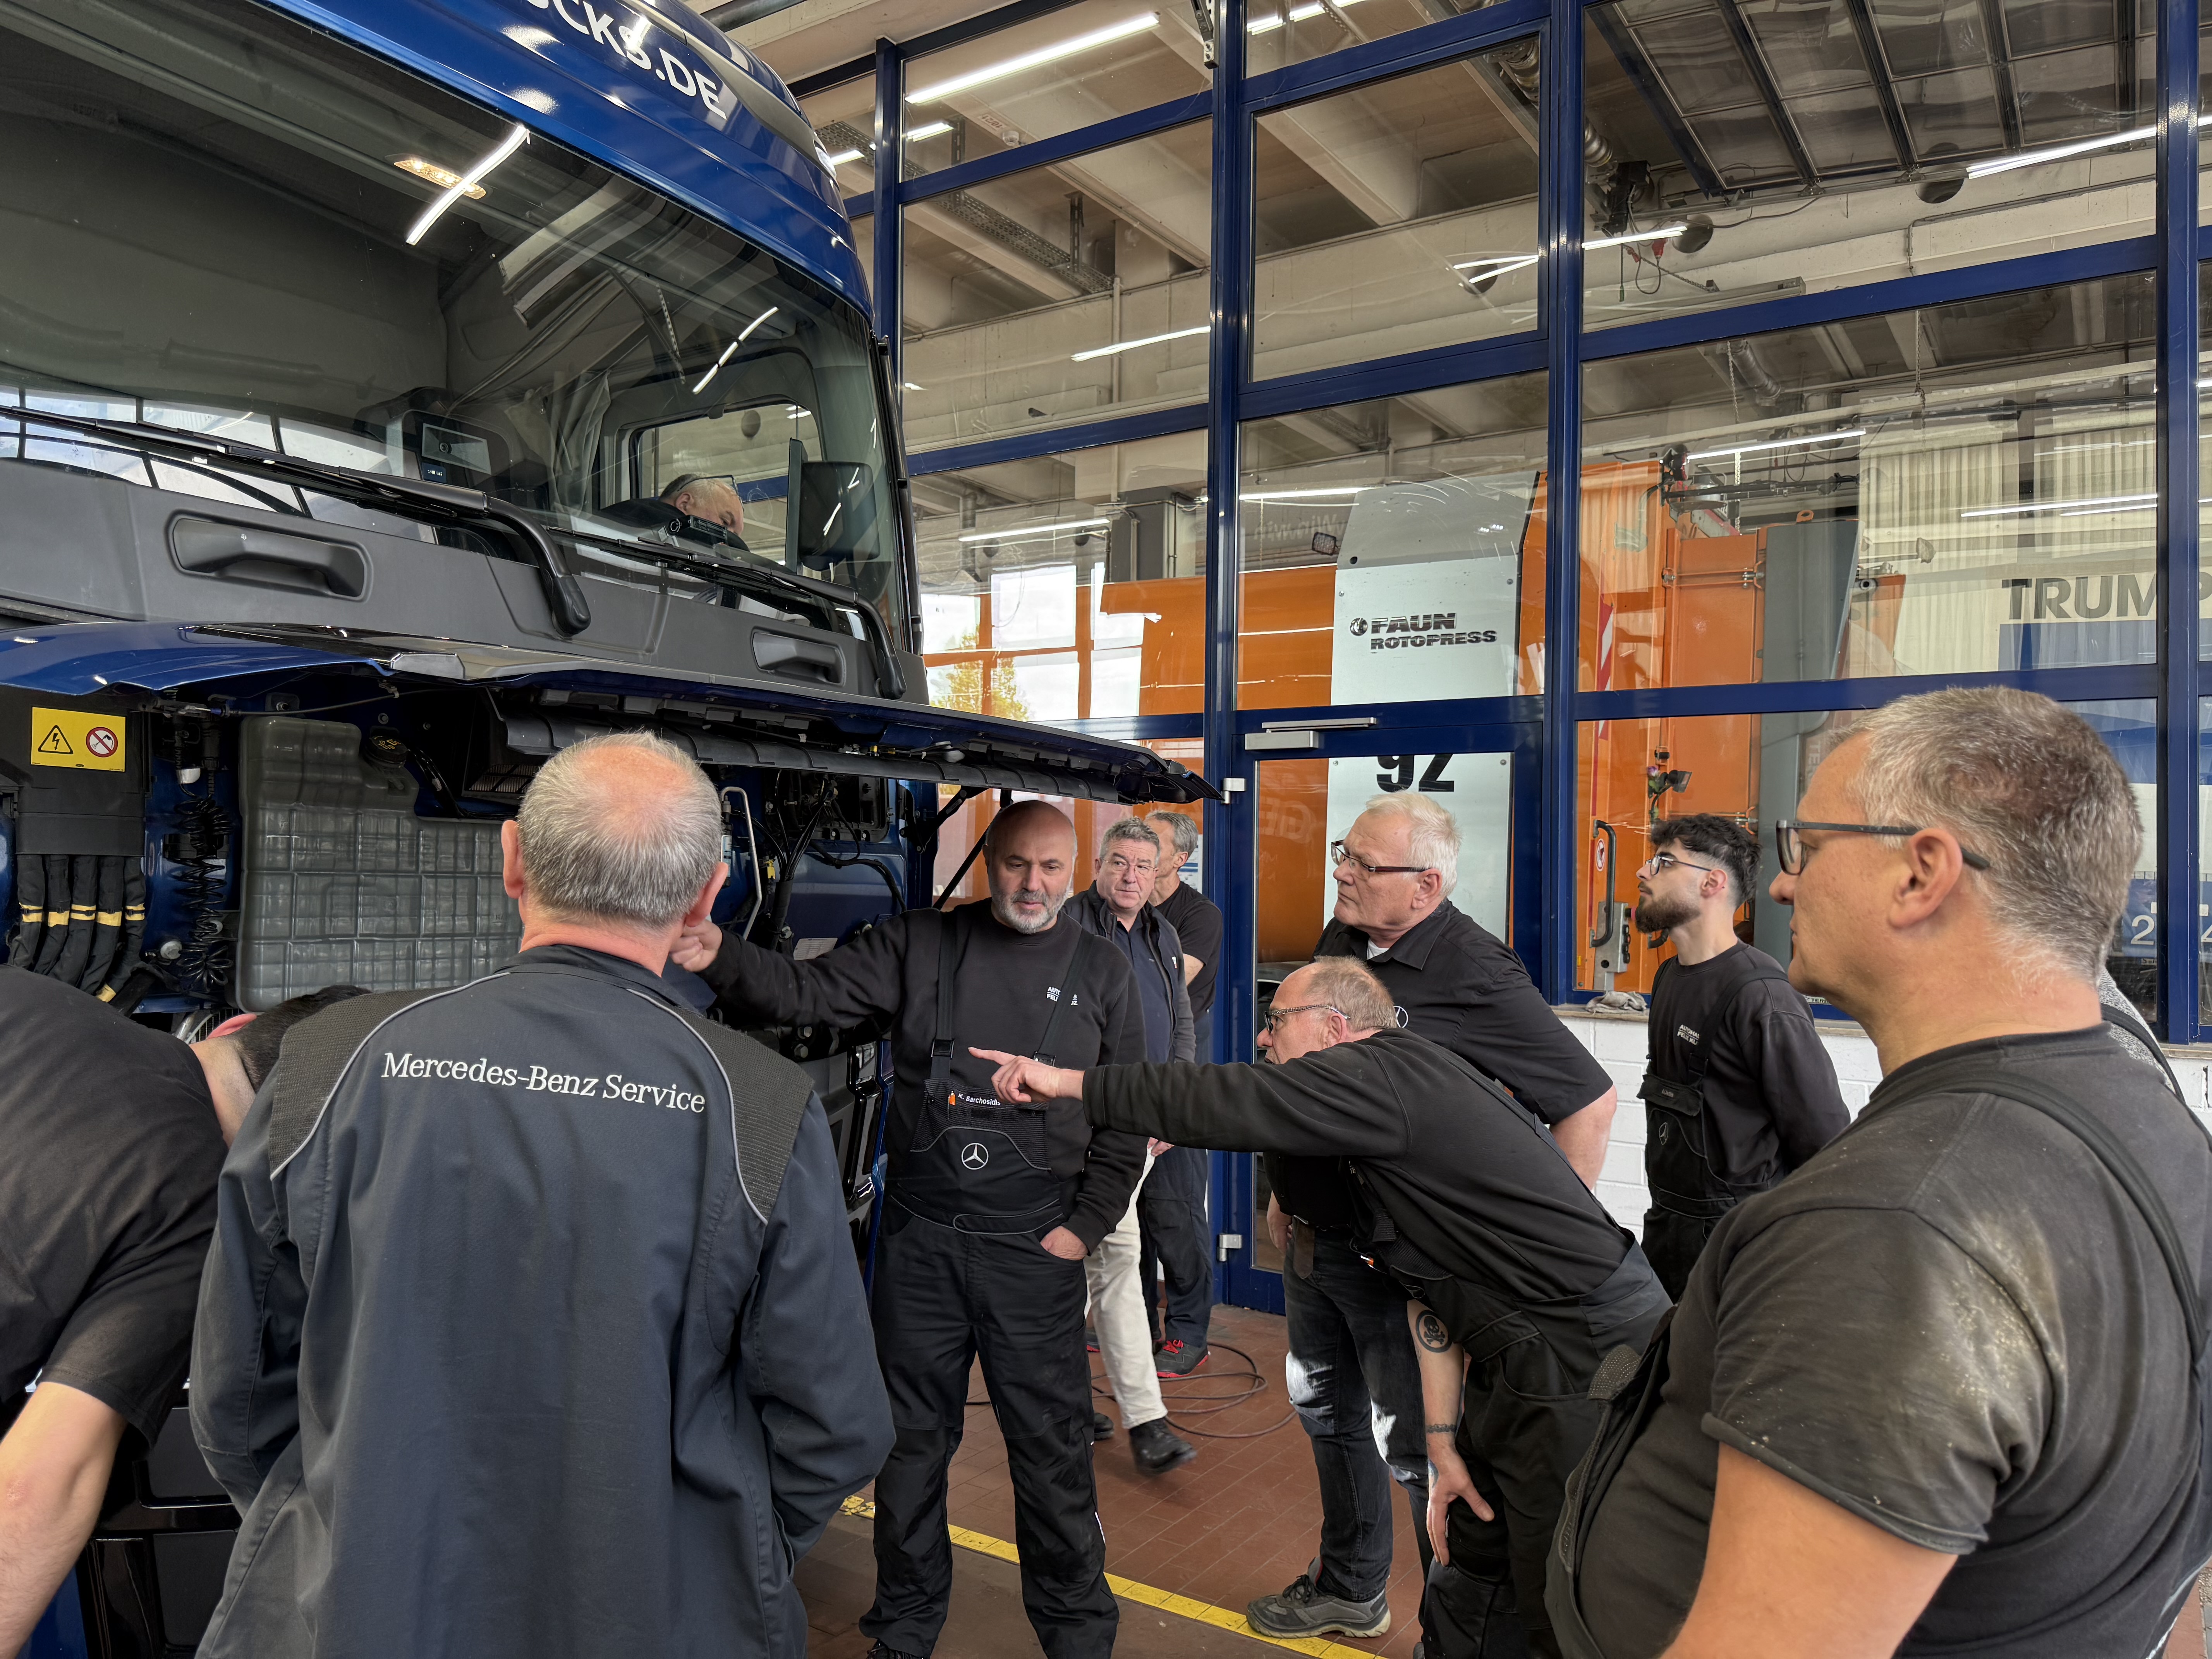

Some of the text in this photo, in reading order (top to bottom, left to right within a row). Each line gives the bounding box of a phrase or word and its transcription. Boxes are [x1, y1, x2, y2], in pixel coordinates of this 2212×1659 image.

[527, 0, 726, 120] CKS.DE
[1370, 630, 1497, 650] ROTOPRESS
[1371, 613, 1457, 634] FAUN
[381, 1053, 706, 1113] Mercedes-Benz Service
